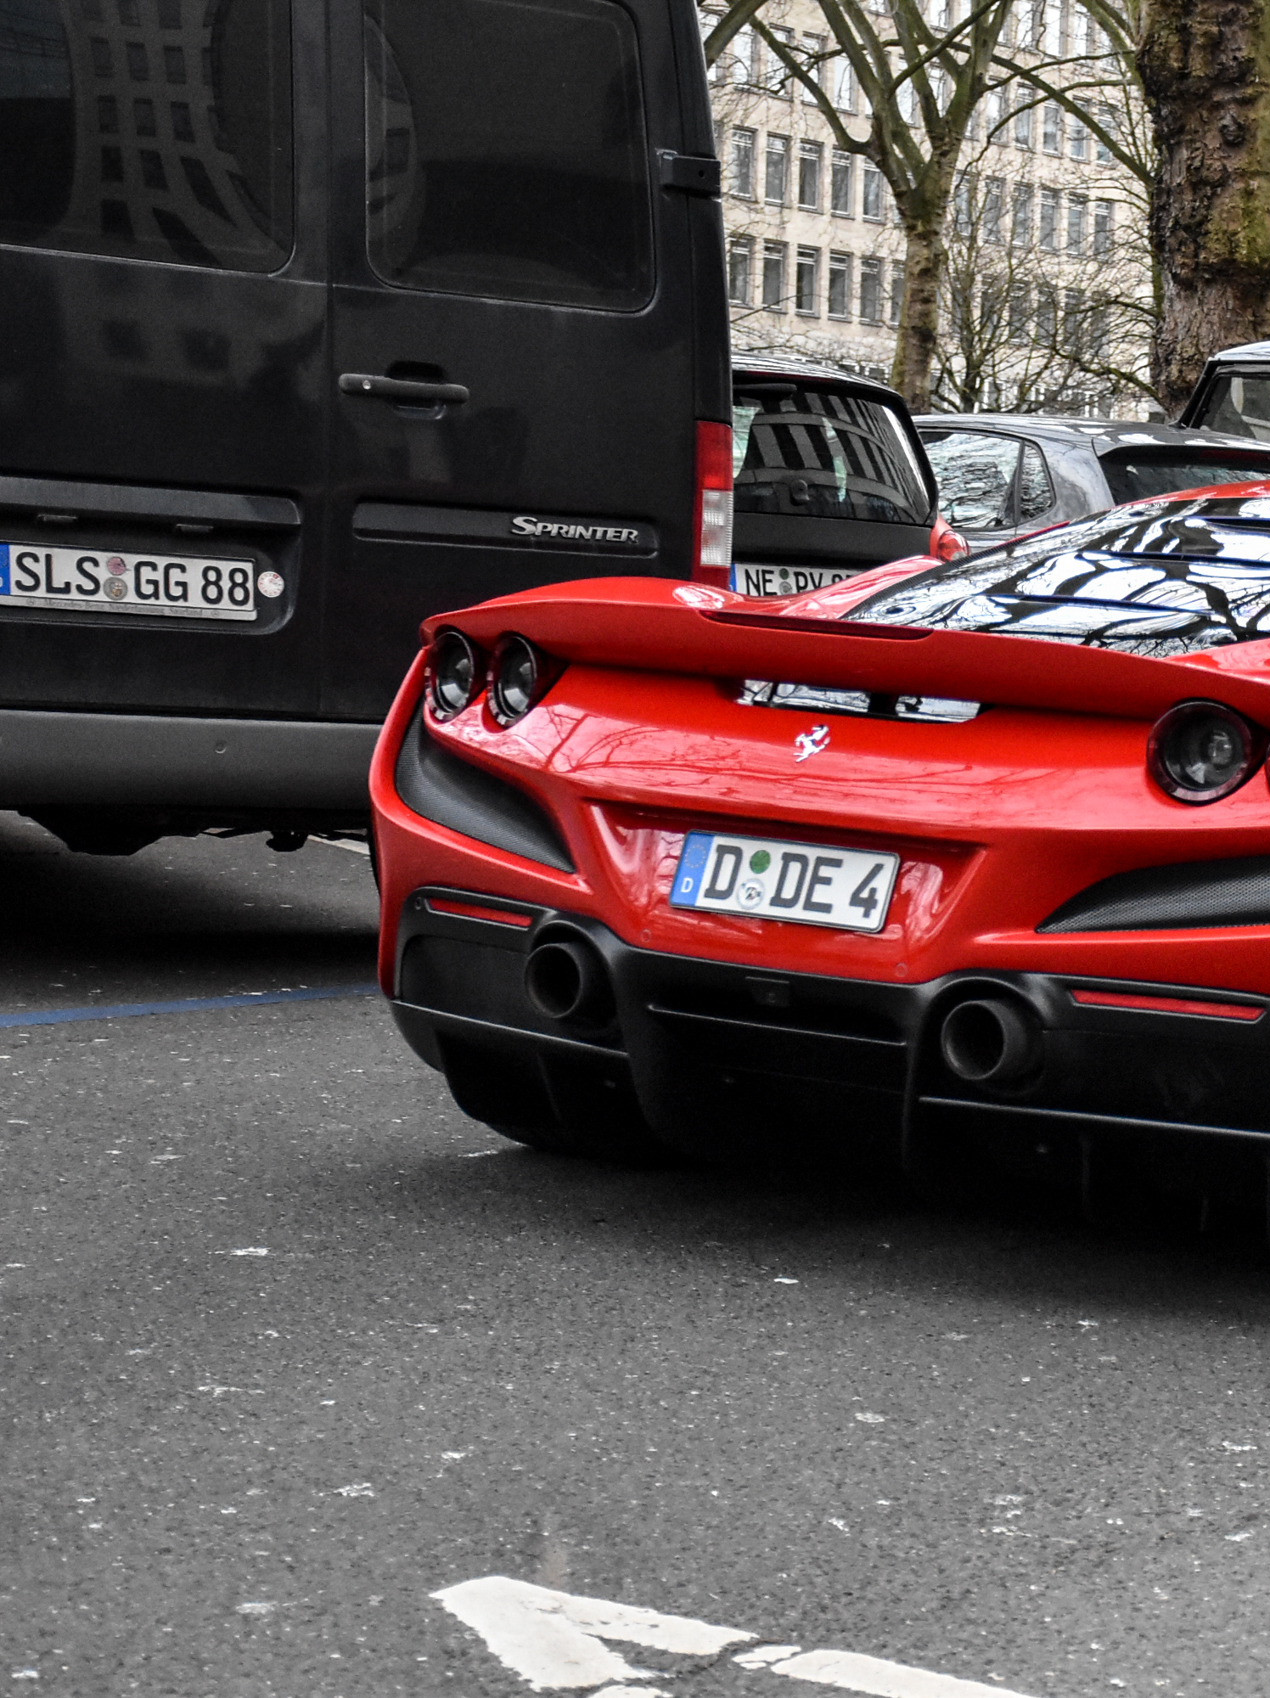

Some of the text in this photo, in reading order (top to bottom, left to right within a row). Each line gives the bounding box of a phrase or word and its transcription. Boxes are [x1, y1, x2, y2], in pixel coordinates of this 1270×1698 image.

[15, 552, 250, 606] SLS GG 88
[745, 569, 778, 596] NE
[704, 845, 884, 918] D DE 4
